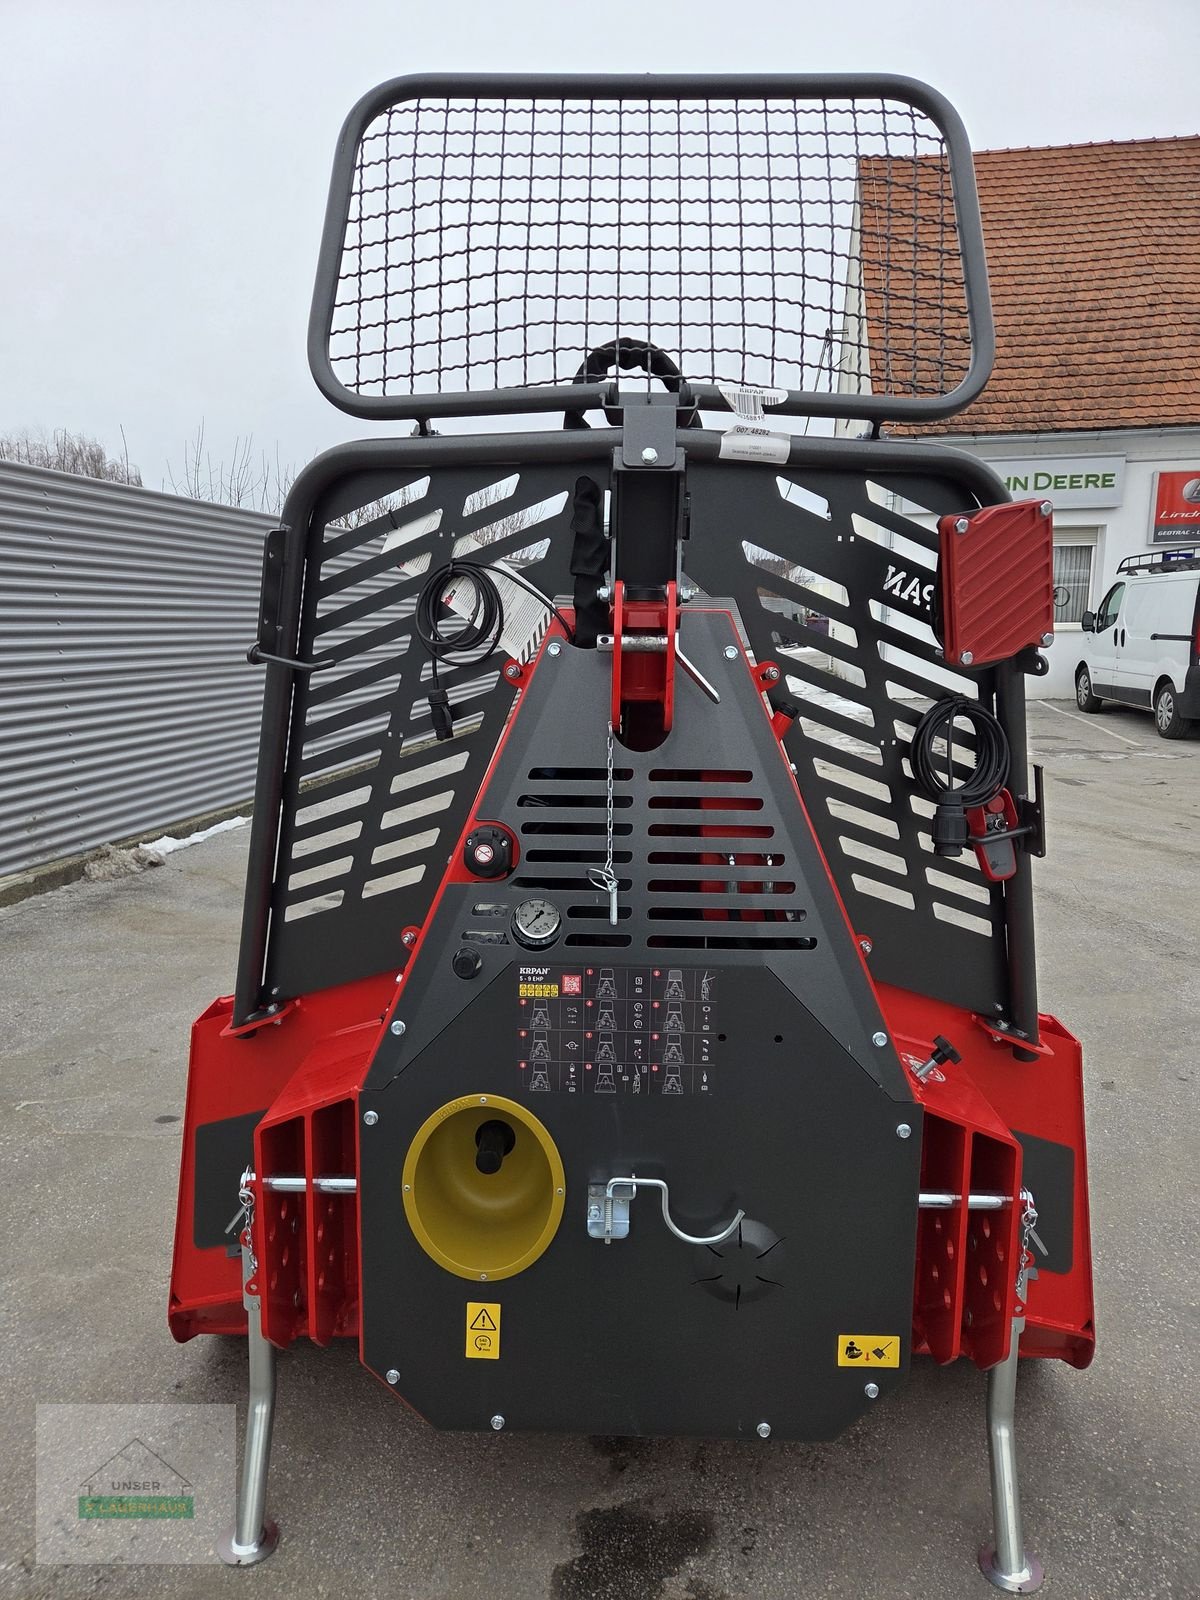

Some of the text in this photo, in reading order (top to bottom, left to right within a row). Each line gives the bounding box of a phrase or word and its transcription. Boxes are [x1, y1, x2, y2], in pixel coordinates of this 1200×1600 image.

[736, 426, 748, 434] 007
[1034, 472, 1116, 491] DEERE
[519, 967, 547, 975] KRPAN
